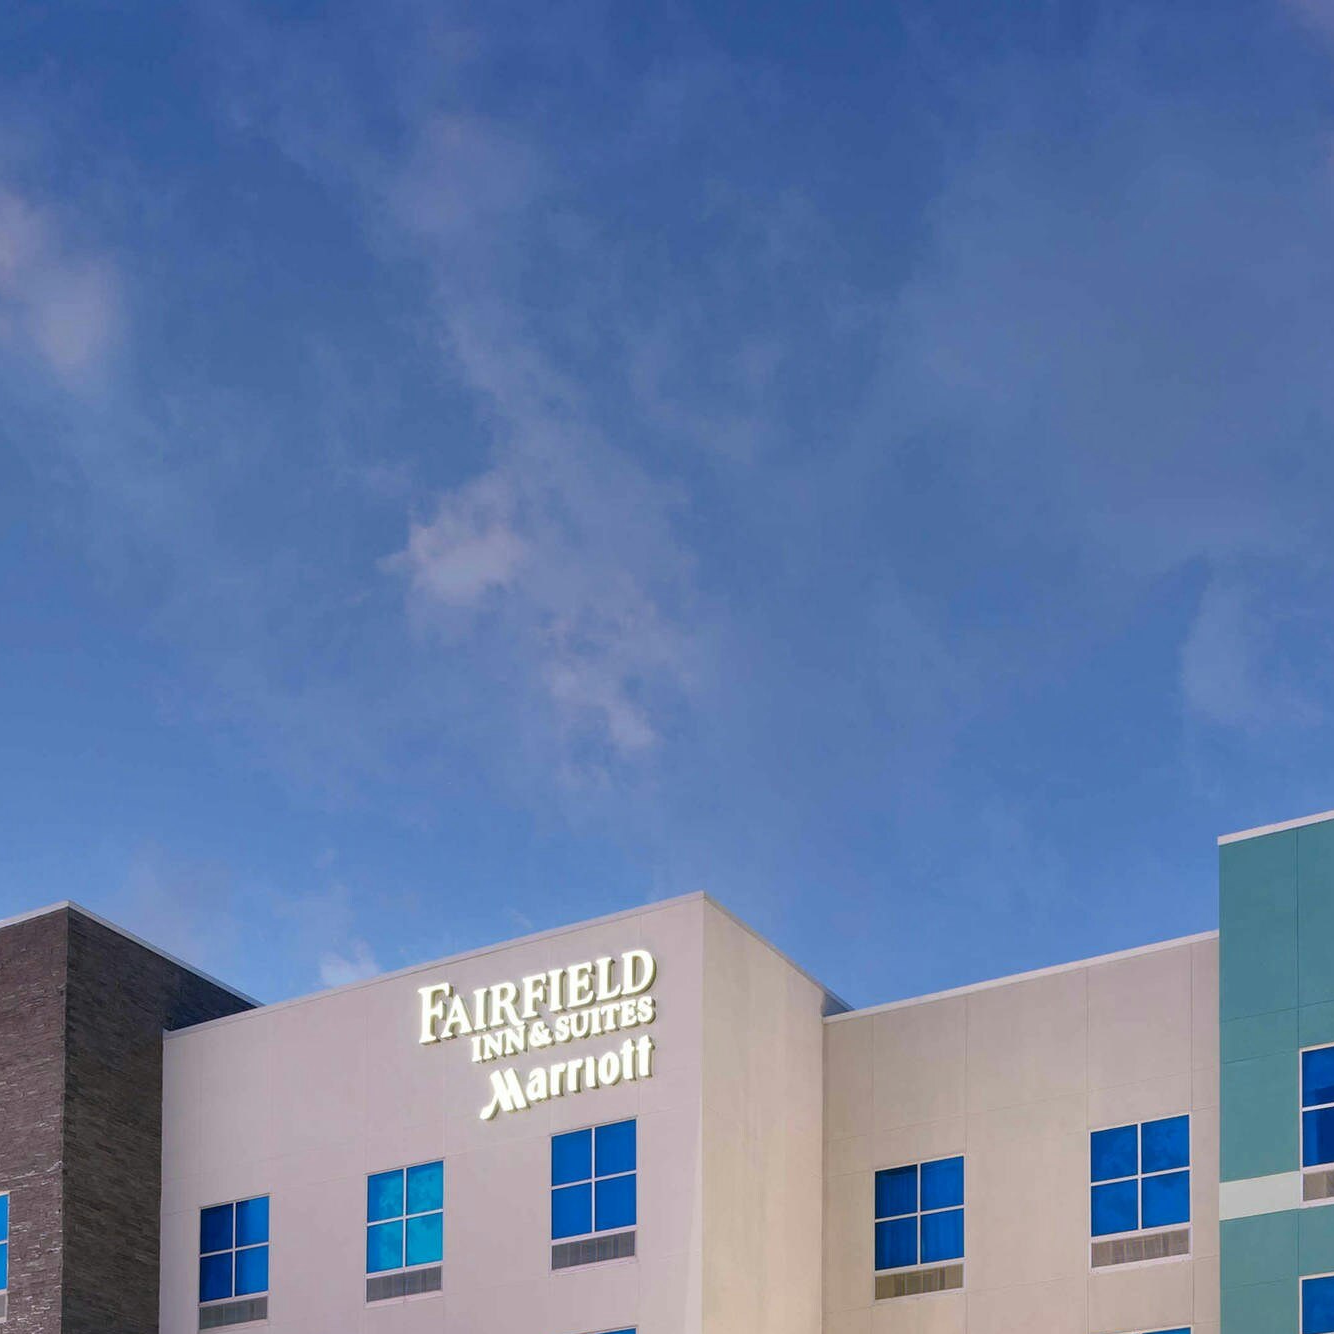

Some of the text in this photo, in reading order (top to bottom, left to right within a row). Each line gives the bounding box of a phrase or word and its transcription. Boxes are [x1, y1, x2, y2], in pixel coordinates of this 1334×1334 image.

[418, 949, 657, 1044] FAIRFIELD
[471, 996, 657, 1063] INN & SUITES
[479, 1034, 656, 1121] Marriott
